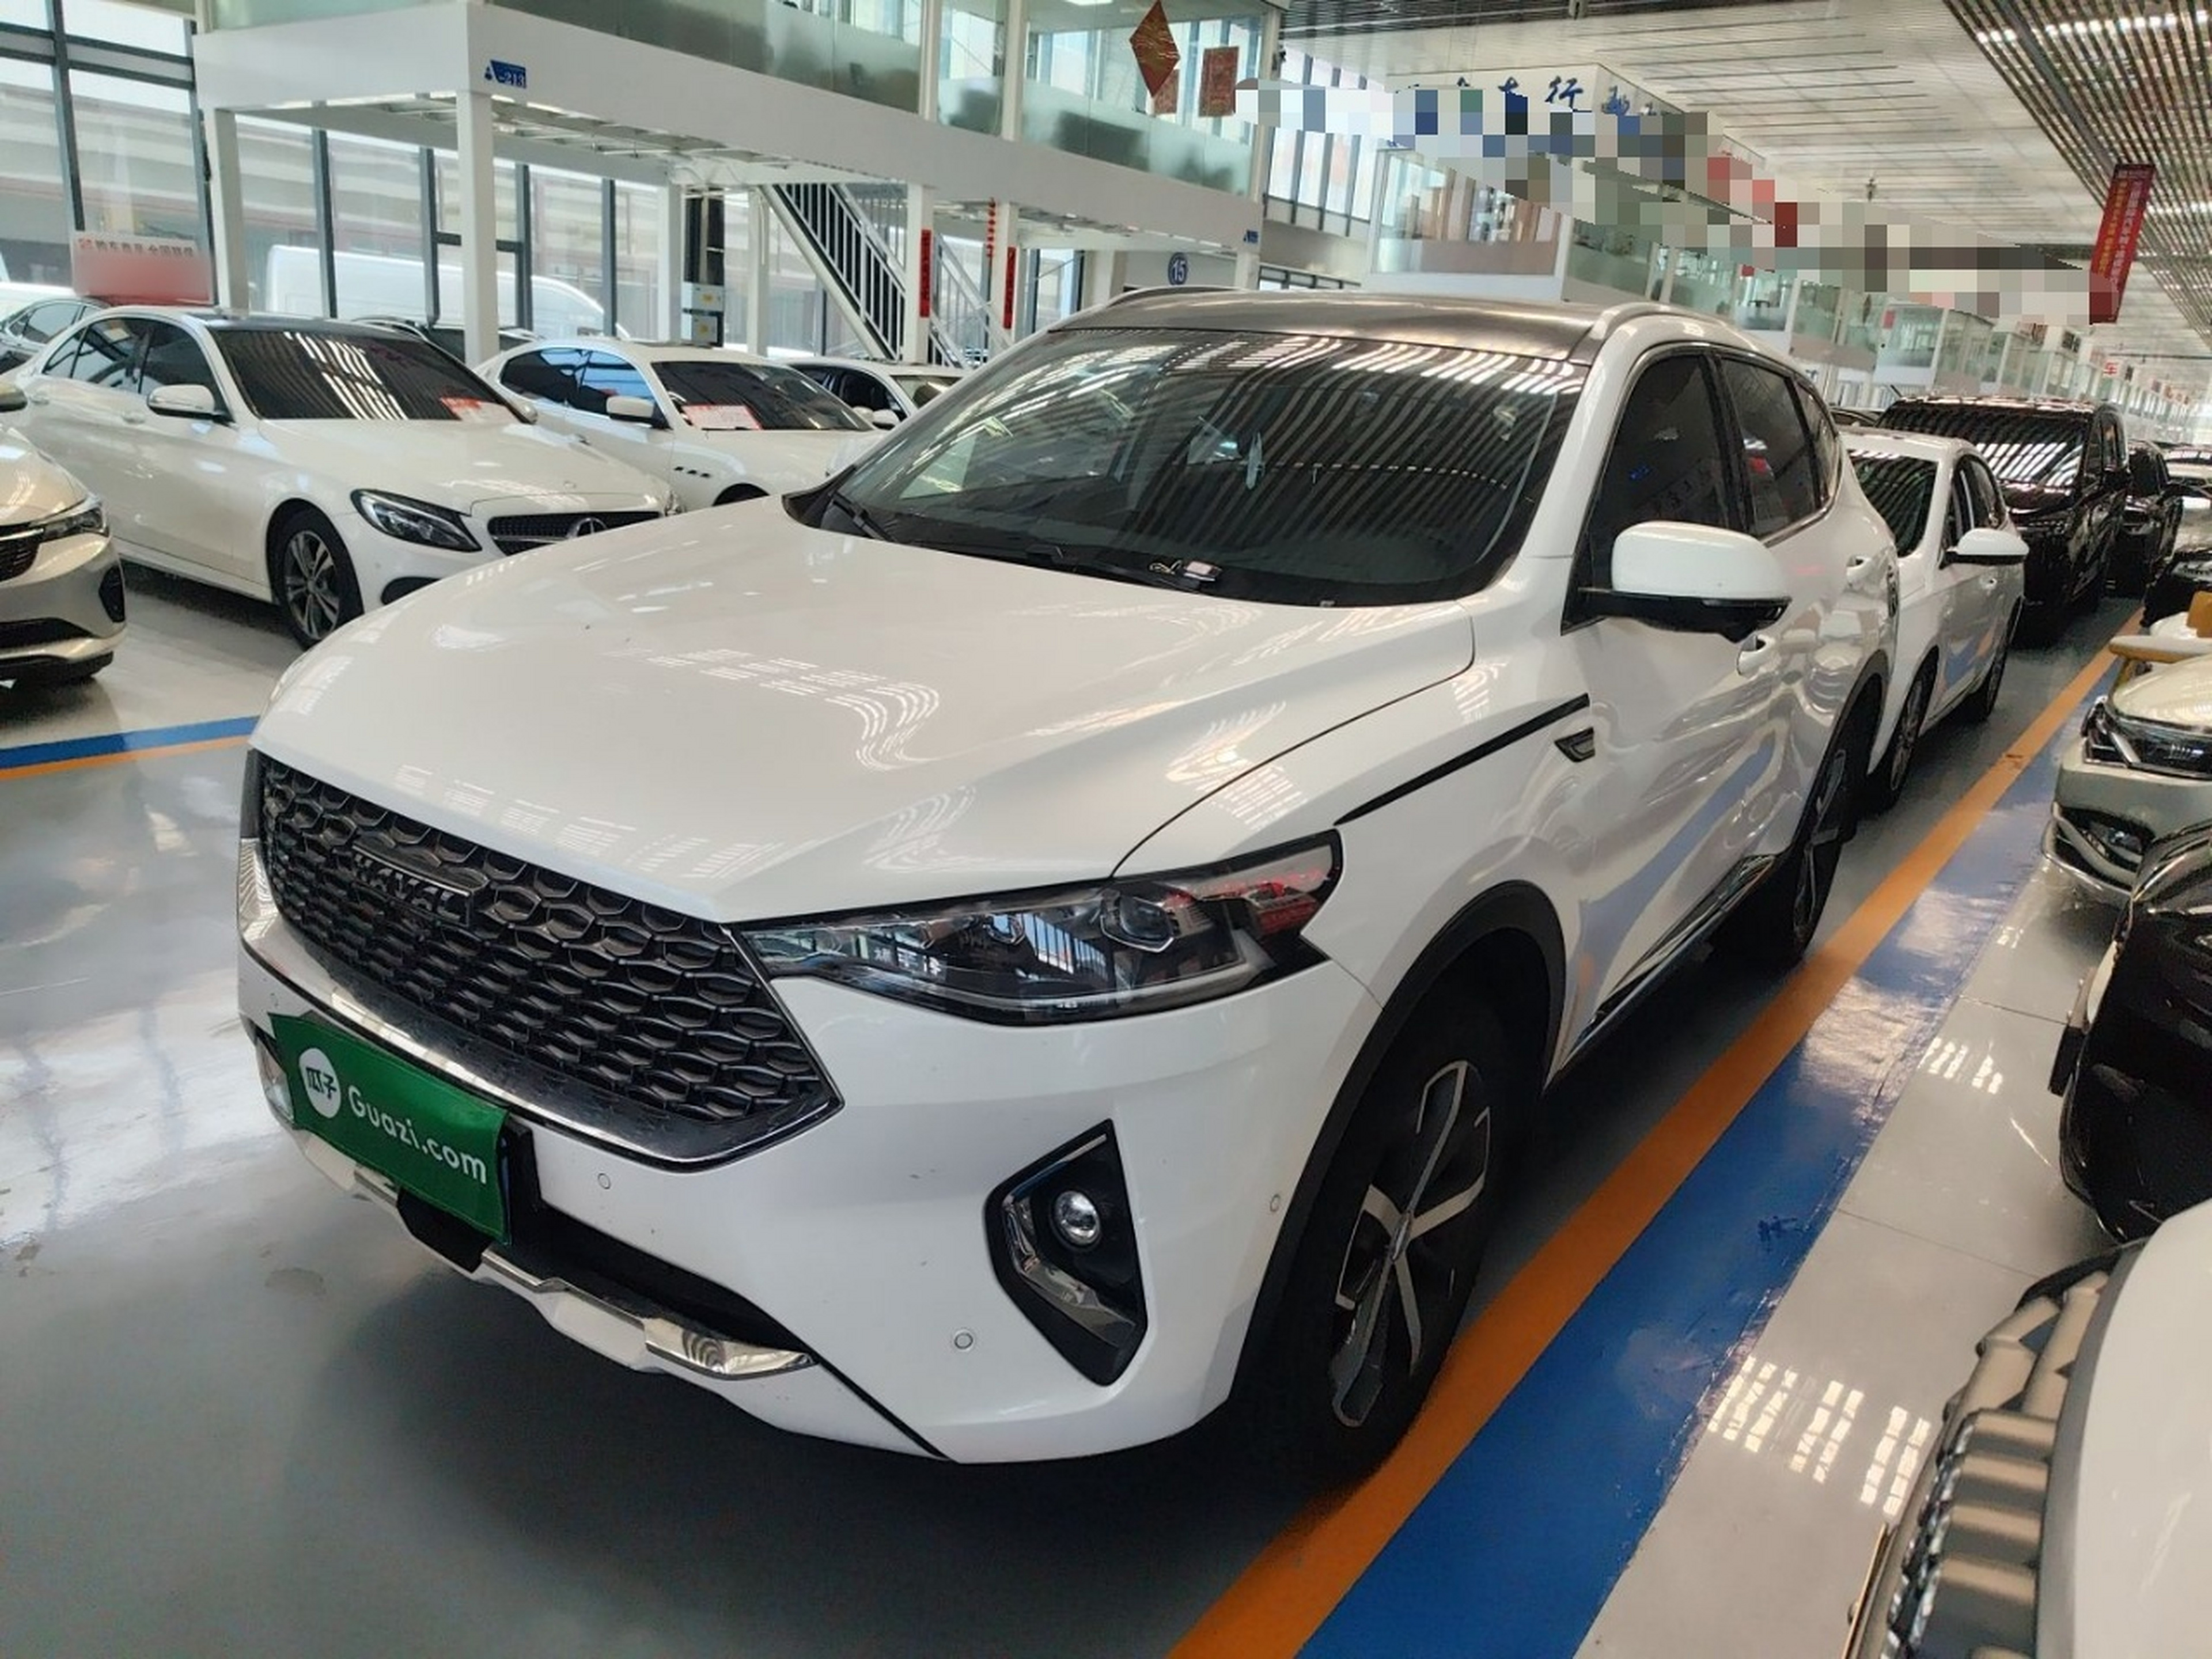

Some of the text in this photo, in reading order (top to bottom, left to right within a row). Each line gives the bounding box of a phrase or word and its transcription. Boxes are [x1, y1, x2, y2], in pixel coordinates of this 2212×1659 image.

[1172, 259, 1186, 281] 15
[306, 1066, 337, 1099] 瓜子
[348, 1085, 487, 1184] Guazi.com
